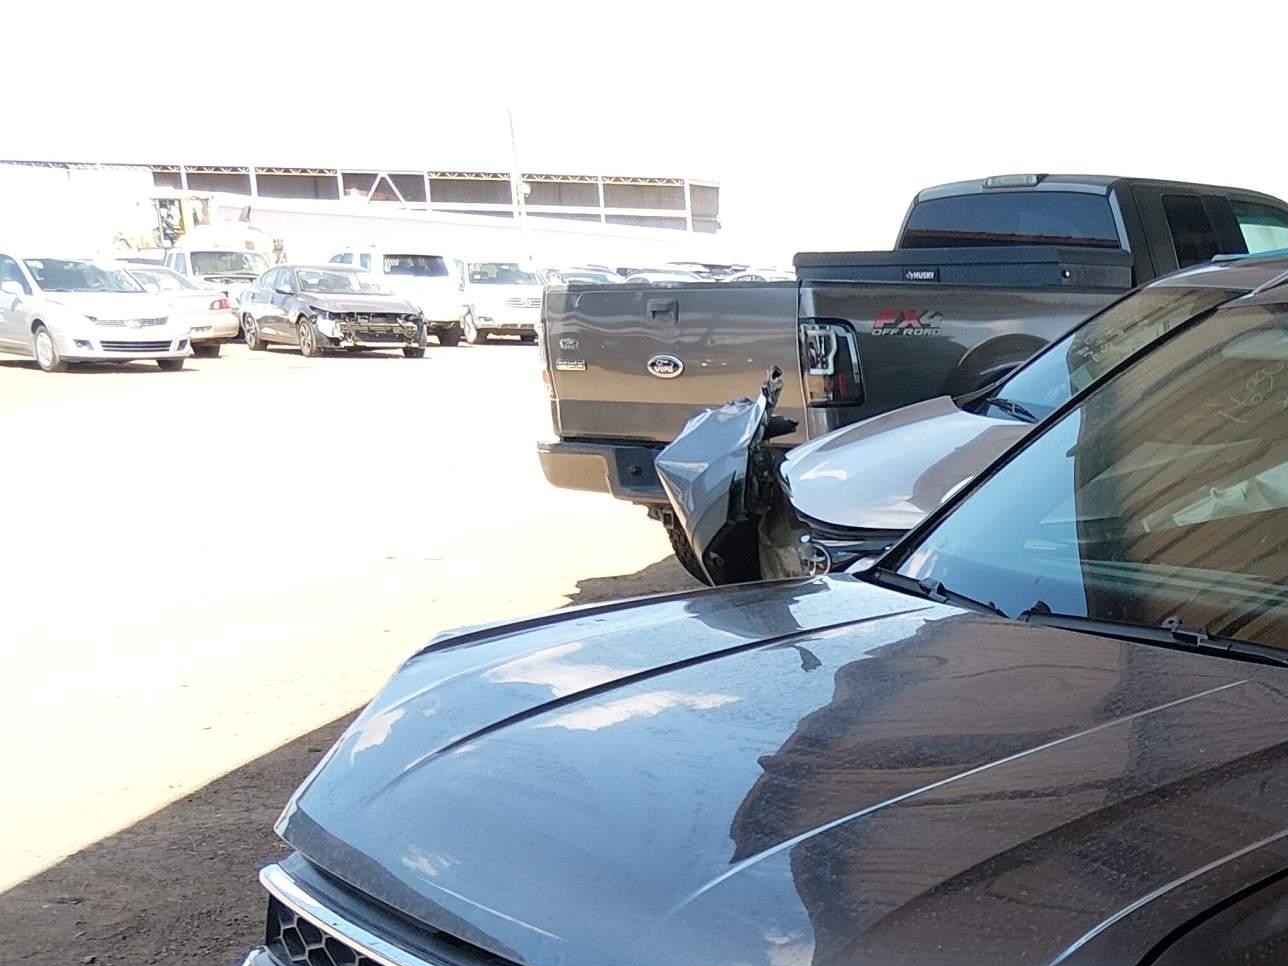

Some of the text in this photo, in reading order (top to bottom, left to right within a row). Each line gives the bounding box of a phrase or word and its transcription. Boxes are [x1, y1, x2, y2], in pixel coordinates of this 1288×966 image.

[913, 271, 935, 280] HUSKY
[873, 309, 943, 328] FX4
[871, 328, 941, 336] OFF ROAD
